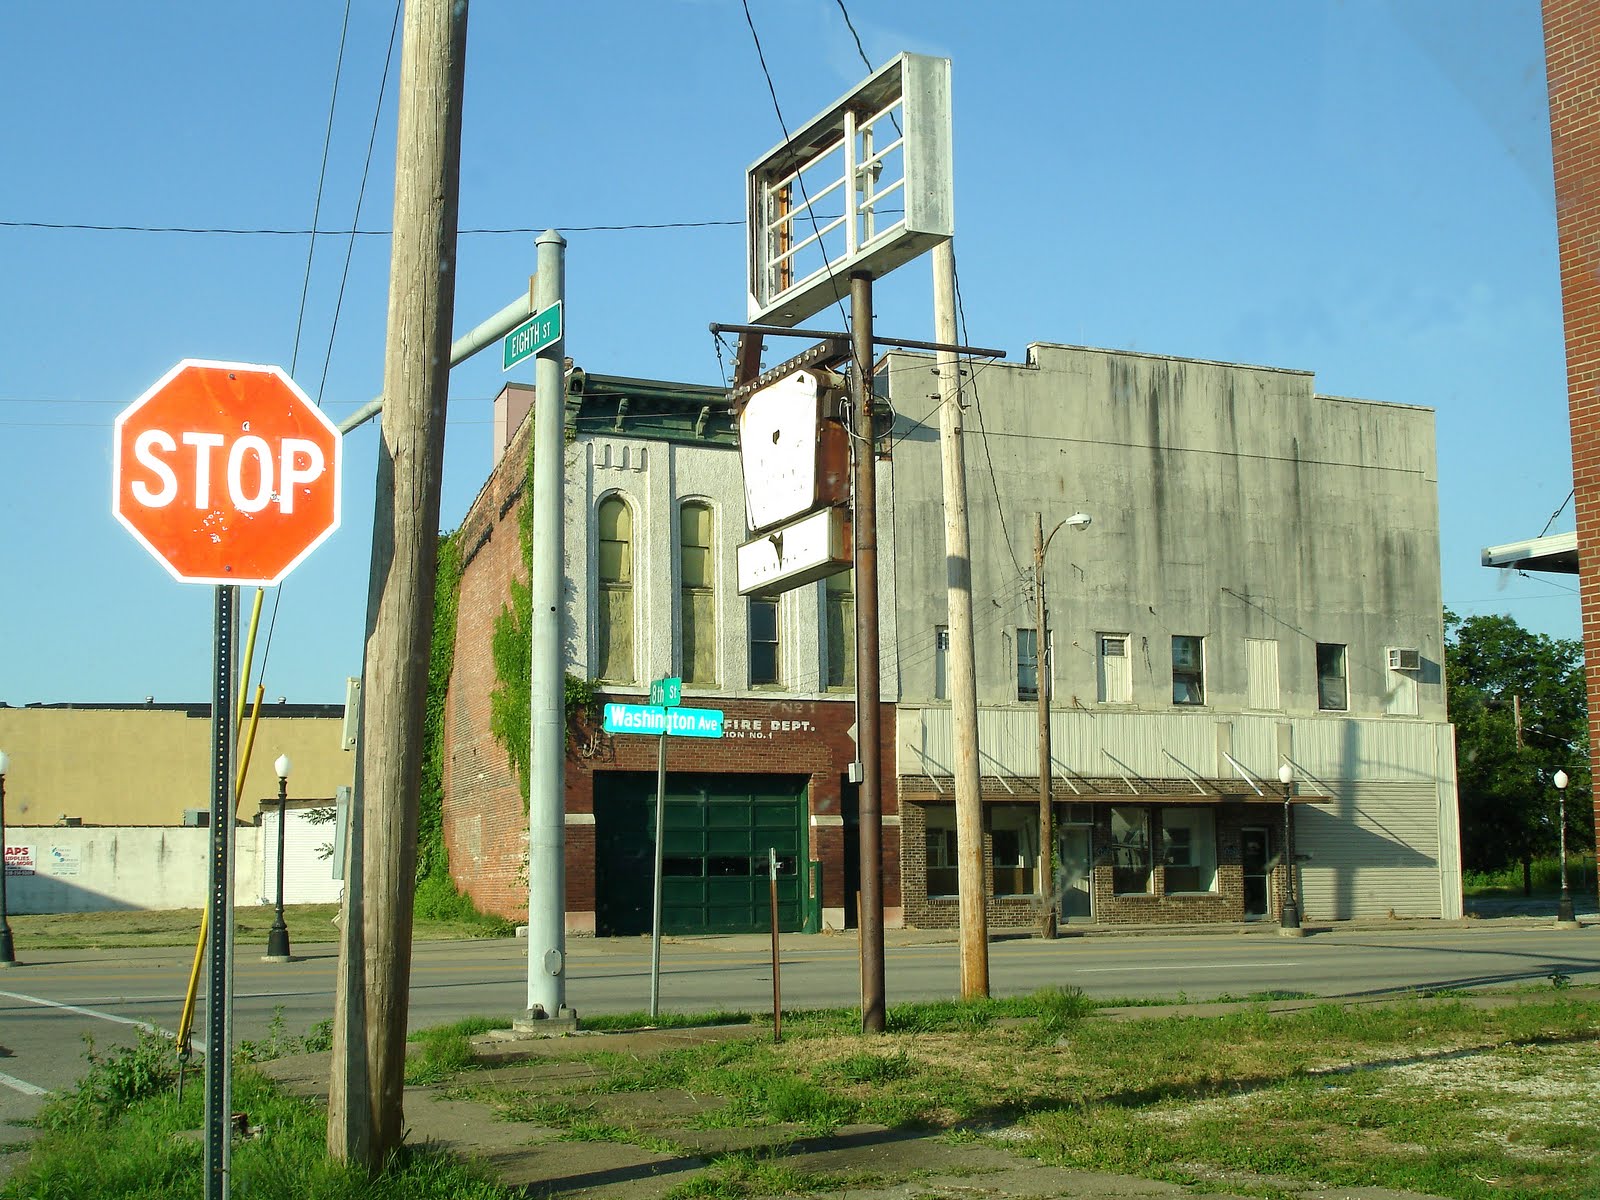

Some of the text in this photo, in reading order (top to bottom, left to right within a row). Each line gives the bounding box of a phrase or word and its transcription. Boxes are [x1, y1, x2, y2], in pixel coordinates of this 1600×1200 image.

[511, 321, 551, 358] EIGHTH ST
[131, 429, 325, 514] STOP
[651, 685, 677, 704] 8th St
[611, 705, 718, 734] Washington Ave
[723, 719, 816, 732] FIRE DEPT.
